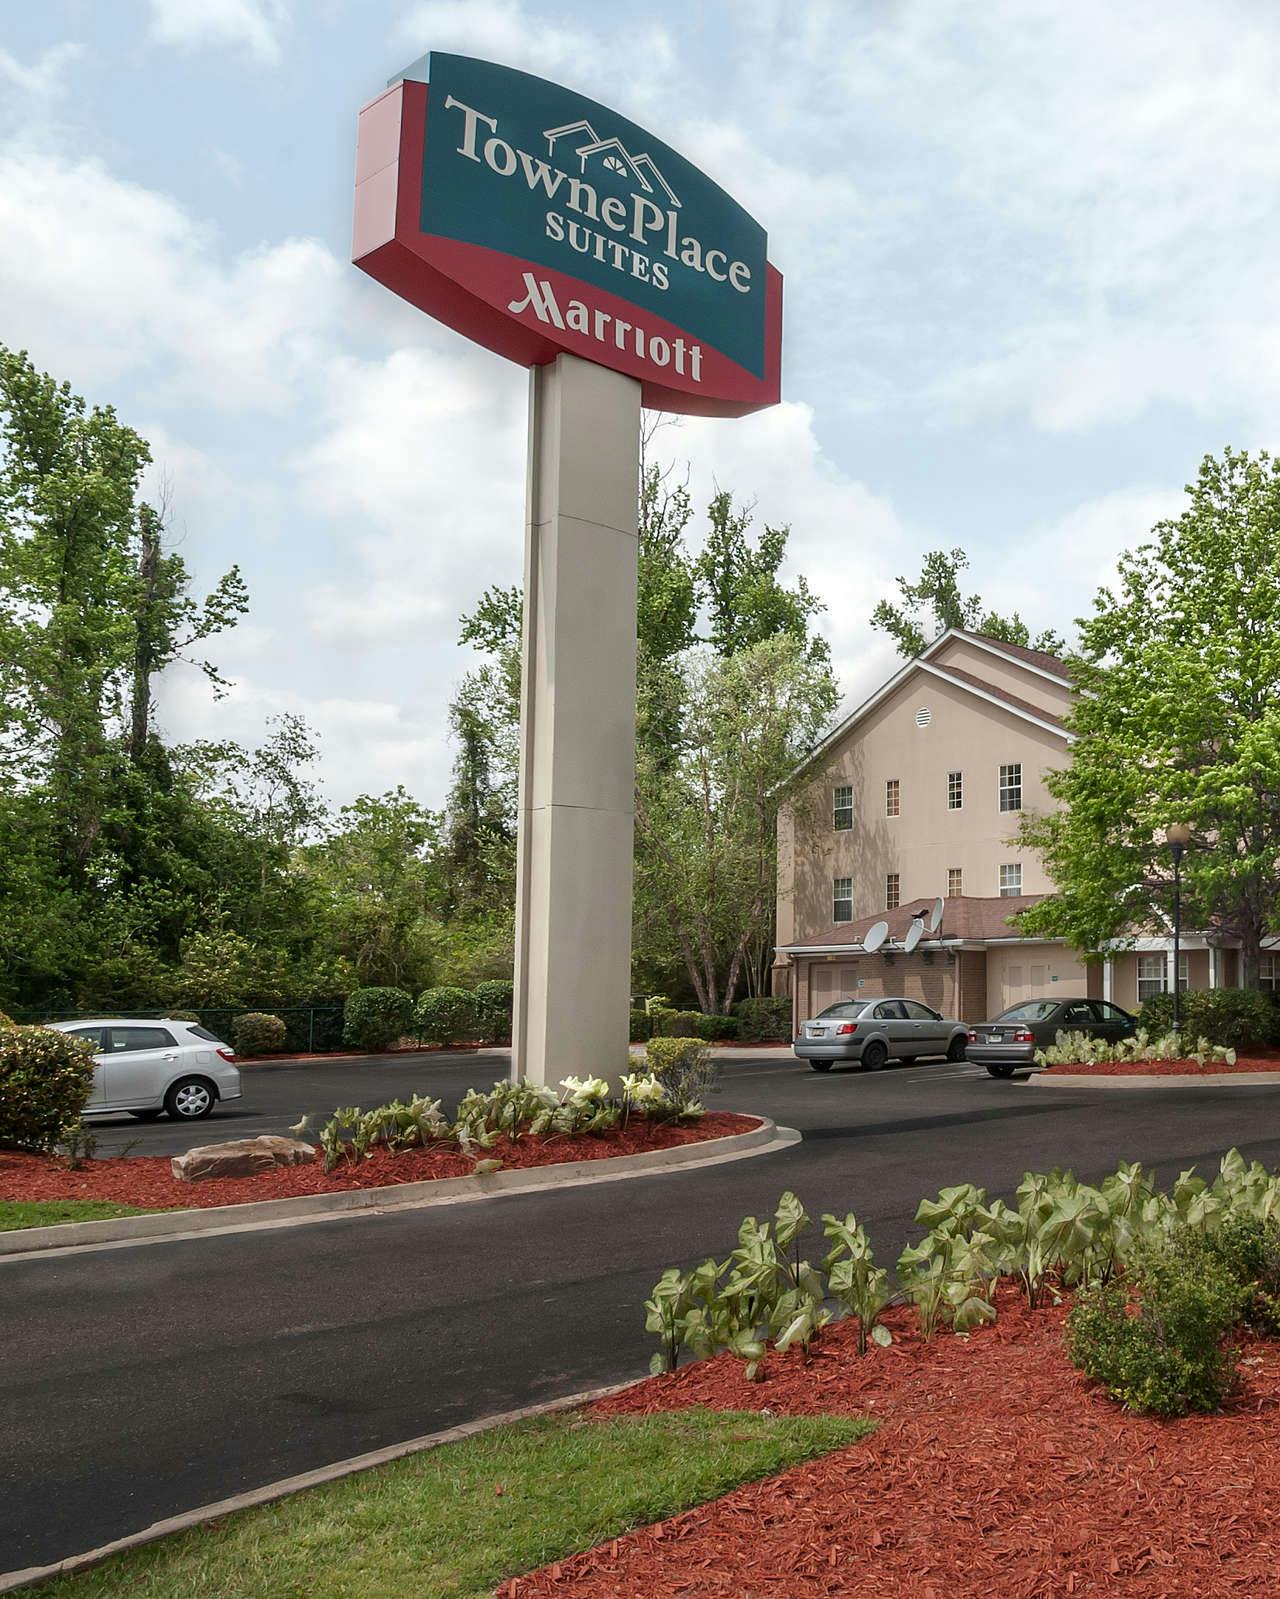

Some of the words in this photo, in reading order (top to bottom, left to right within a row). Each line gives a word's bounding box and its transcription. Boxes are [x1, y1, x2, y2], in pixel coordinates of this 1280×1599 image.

[445, 95, 751, 293] TownePlace
[546, 211, 670, 290] SUITES
[507, 272, 703, 382] Marriott
